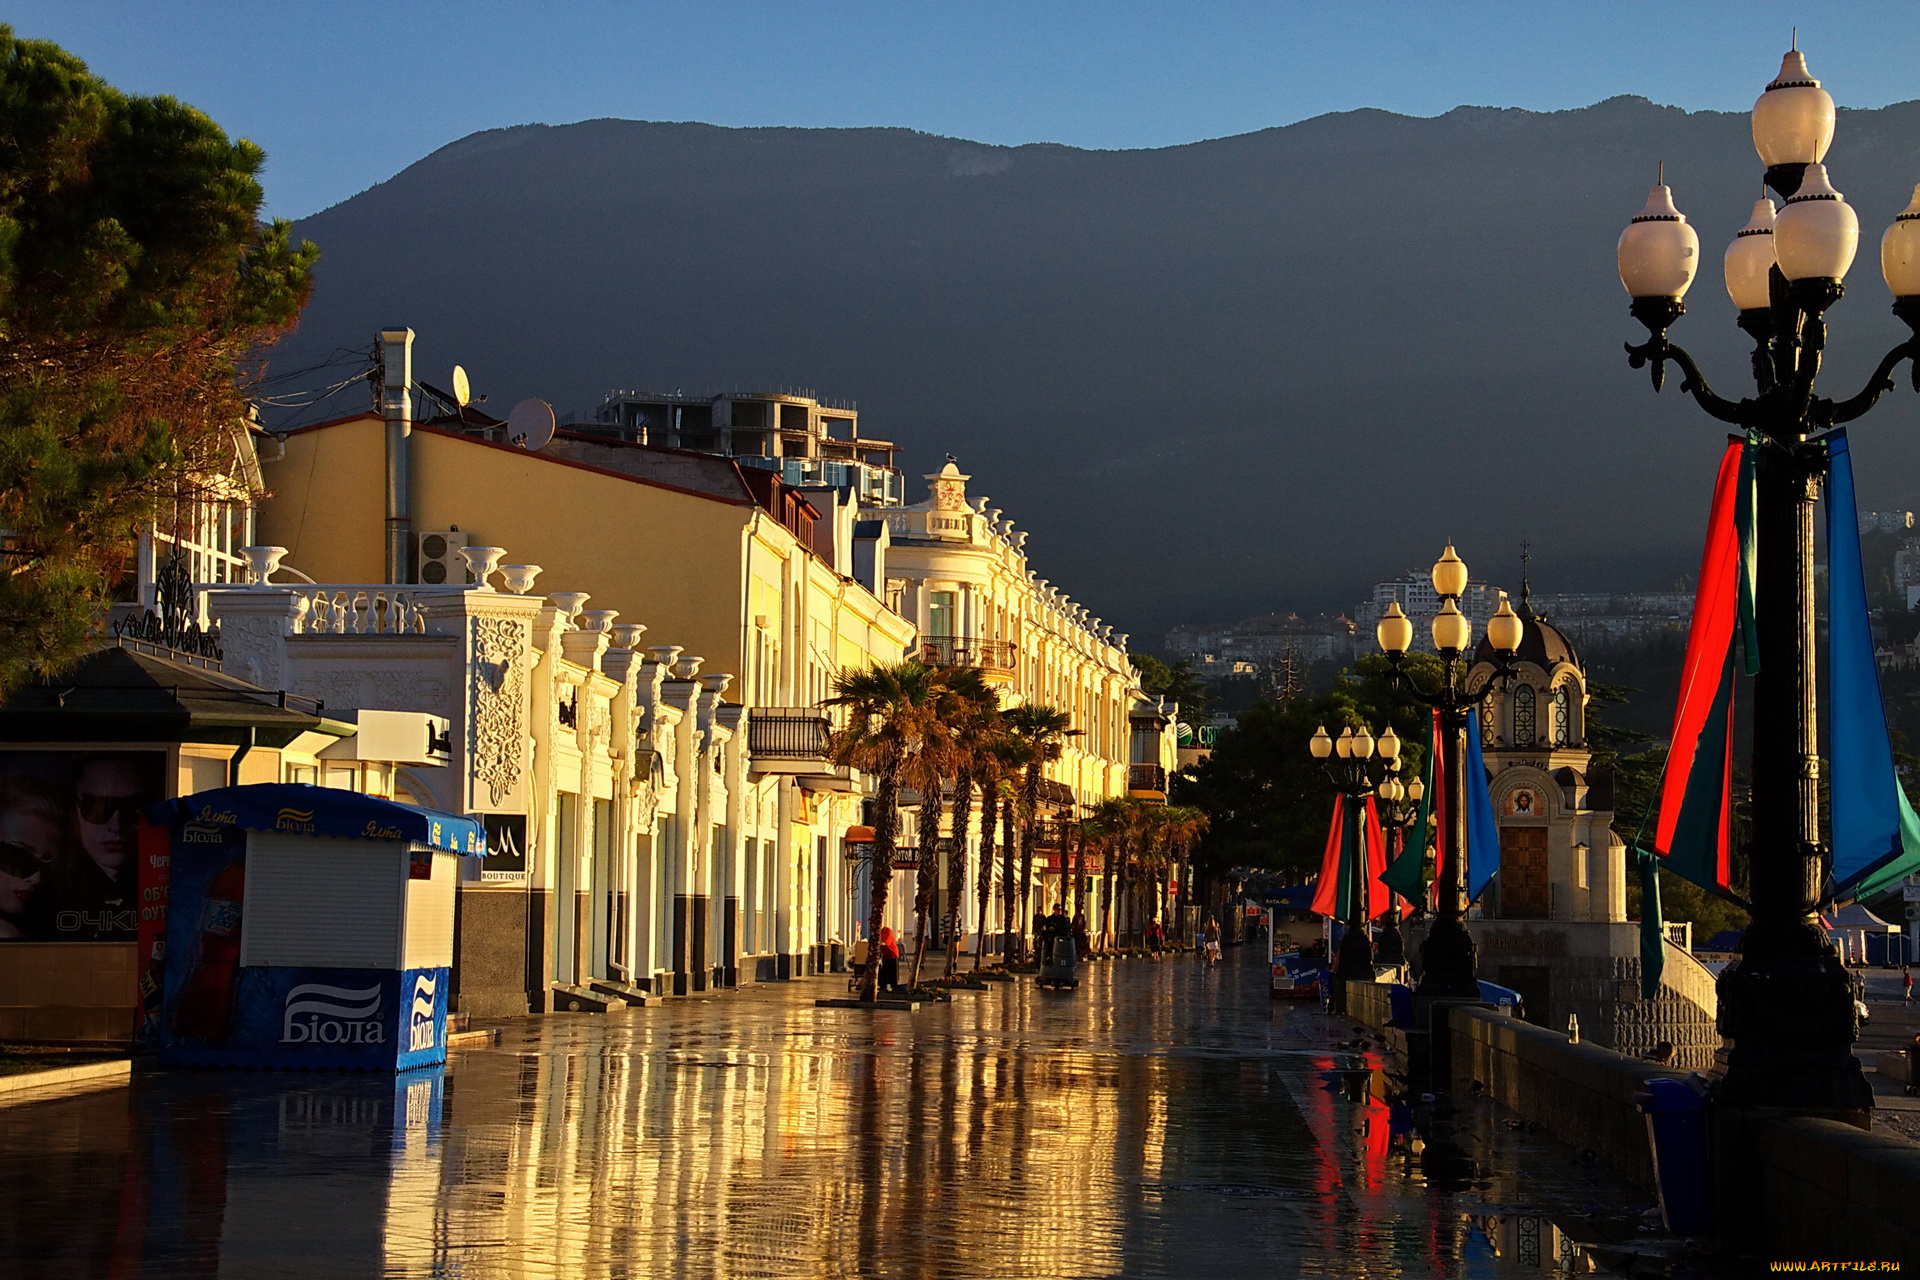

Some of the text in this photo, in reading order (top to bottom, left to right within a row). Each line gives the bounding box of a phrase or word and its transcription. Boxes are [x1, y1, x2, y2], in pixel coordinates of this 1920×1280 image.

[275, 813, 315, 833] Біола
[183, 825, 223, 843] Біола
[482, 873, 526, 881] BOUTIQUE
[56, 910, 139, 932] ОЧК
[278, 994, 387, 1044] Біола
[409, 997, 434, 1052] Біола
